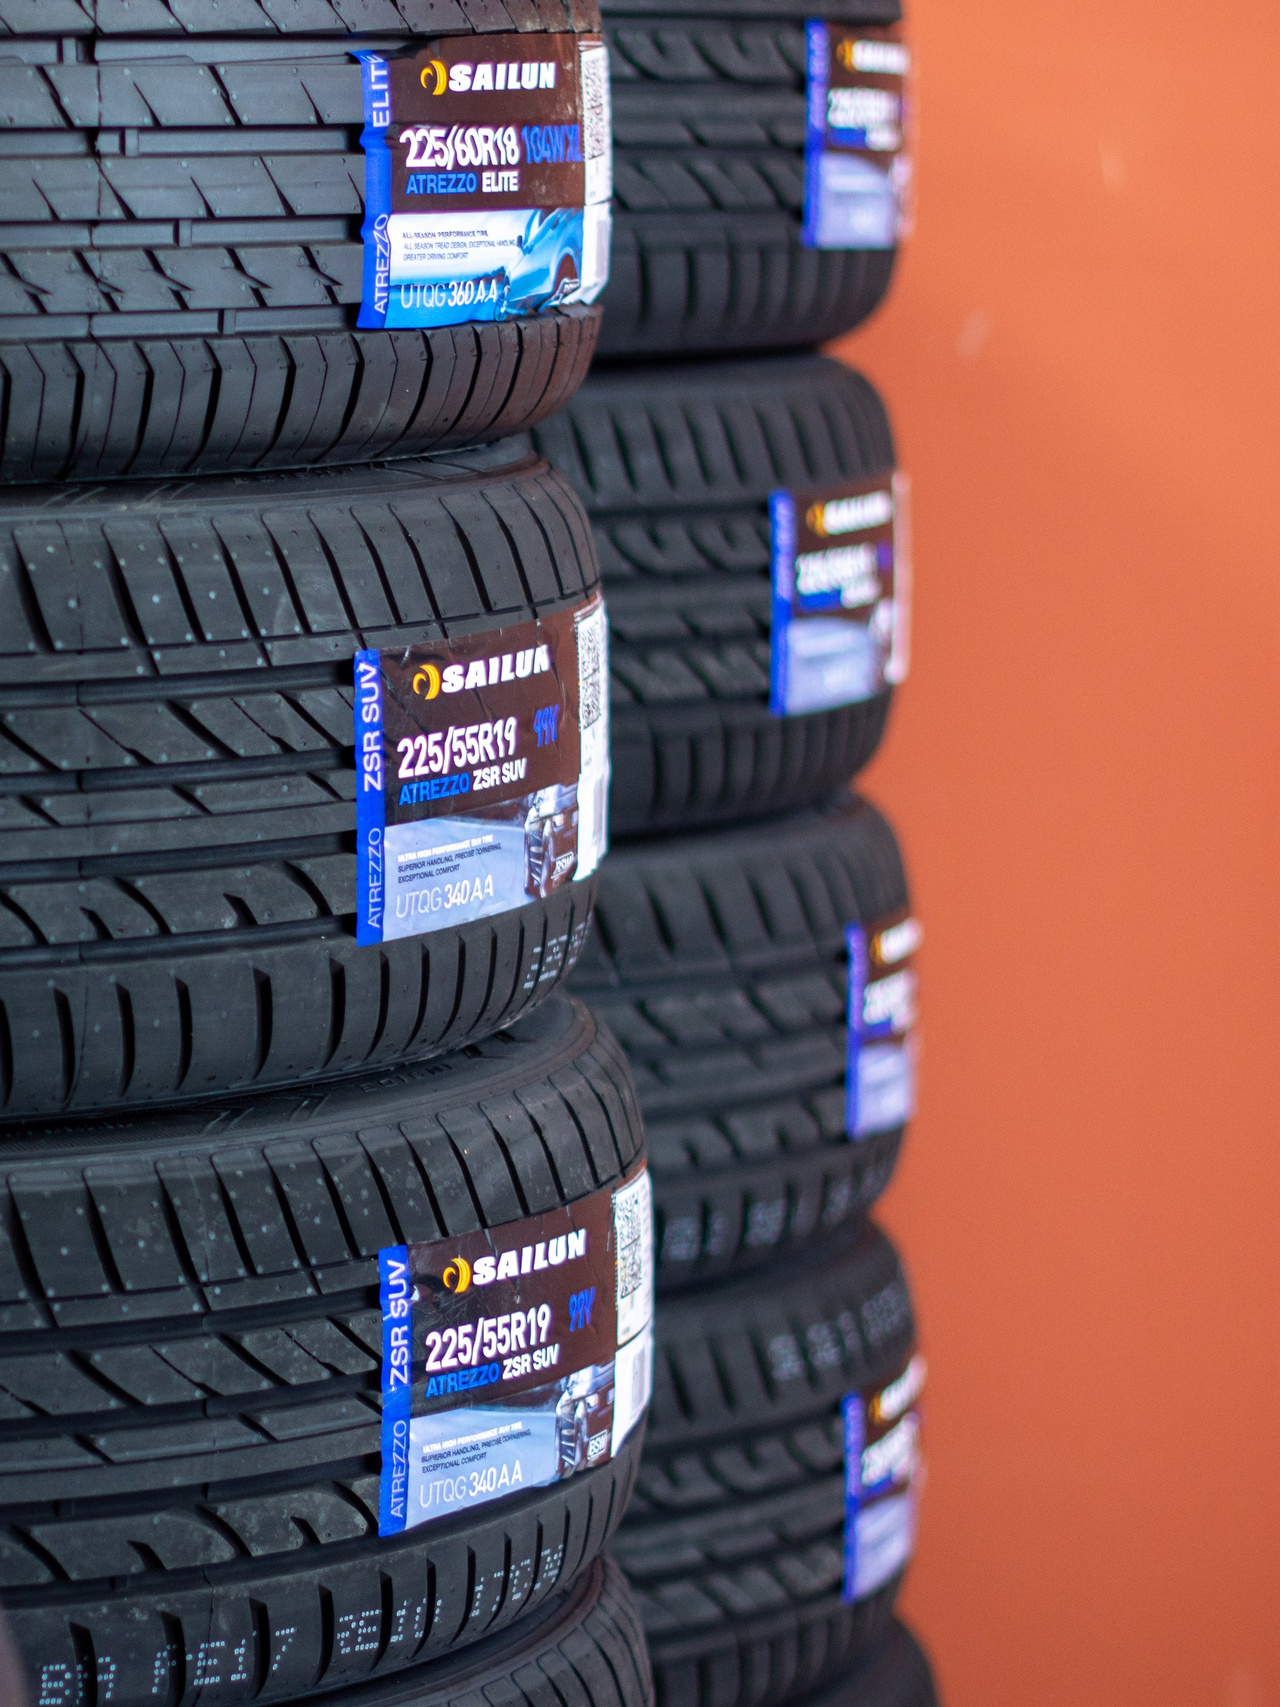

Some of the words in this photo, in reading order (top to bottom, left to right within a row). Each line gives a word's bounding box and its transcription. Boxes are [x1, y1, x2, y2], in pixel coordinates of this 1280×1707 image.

[360, 54, 390, 128] ELITE
[448, 61, 557, 92] SAILUN
[399, 125, 521, 171] 225/60R18
[406, 172, 477, 195] ATREZZO
[481, 171, 520, 193] ELITE
[373, 213, 391, 315] ATREZZO
[401, 283, 447, 308] UTQG
[357, 661, 380, 723] SUV
[441, 644, 551, 694] SAILUN
[363, 730, 382, 792] ZSR
[397, 716, 518, 779] 225/55R19
[398, 772, 470, 806] ATREZZO
[472, 765, 501, 791] ZSR
[501, 757, 528, 784] SUV
[367, 827, 382, 929] ATREZZO
[398, 861, 426, 873] SUPERIOR
[454, 849, 474, 860] PRECISE
[398, 870, 434, 884] EXCEPTIONAL
[435, 864, 460, 876] COMFORT
[395, 887, 442, 918] UTQG
[472, 1228, 586, 1286] SAILUN
[387, 1260, 408, 1318] SUV
[390, 1325, 408, 1386] ZSR
[425, 1303, 551, 1371] 225/55R19
[425, 1363, 501, 1398] ATREZZO
[502, 1353, 531, 1380] ZSR
[532, 1343, 560, 1370] SUV
[391, 1419, 408, 1519] ATREZZO
[421, 1450, 452, 1463] SUPERIOR
[481, 1437, 502, 1449] PRECISE
[422, 1461, 460, 1474] EXCEPTIONAL
[461, 1452, 487, 1465] COMFORT
[420, 1476, 467, 1508] UTQG
